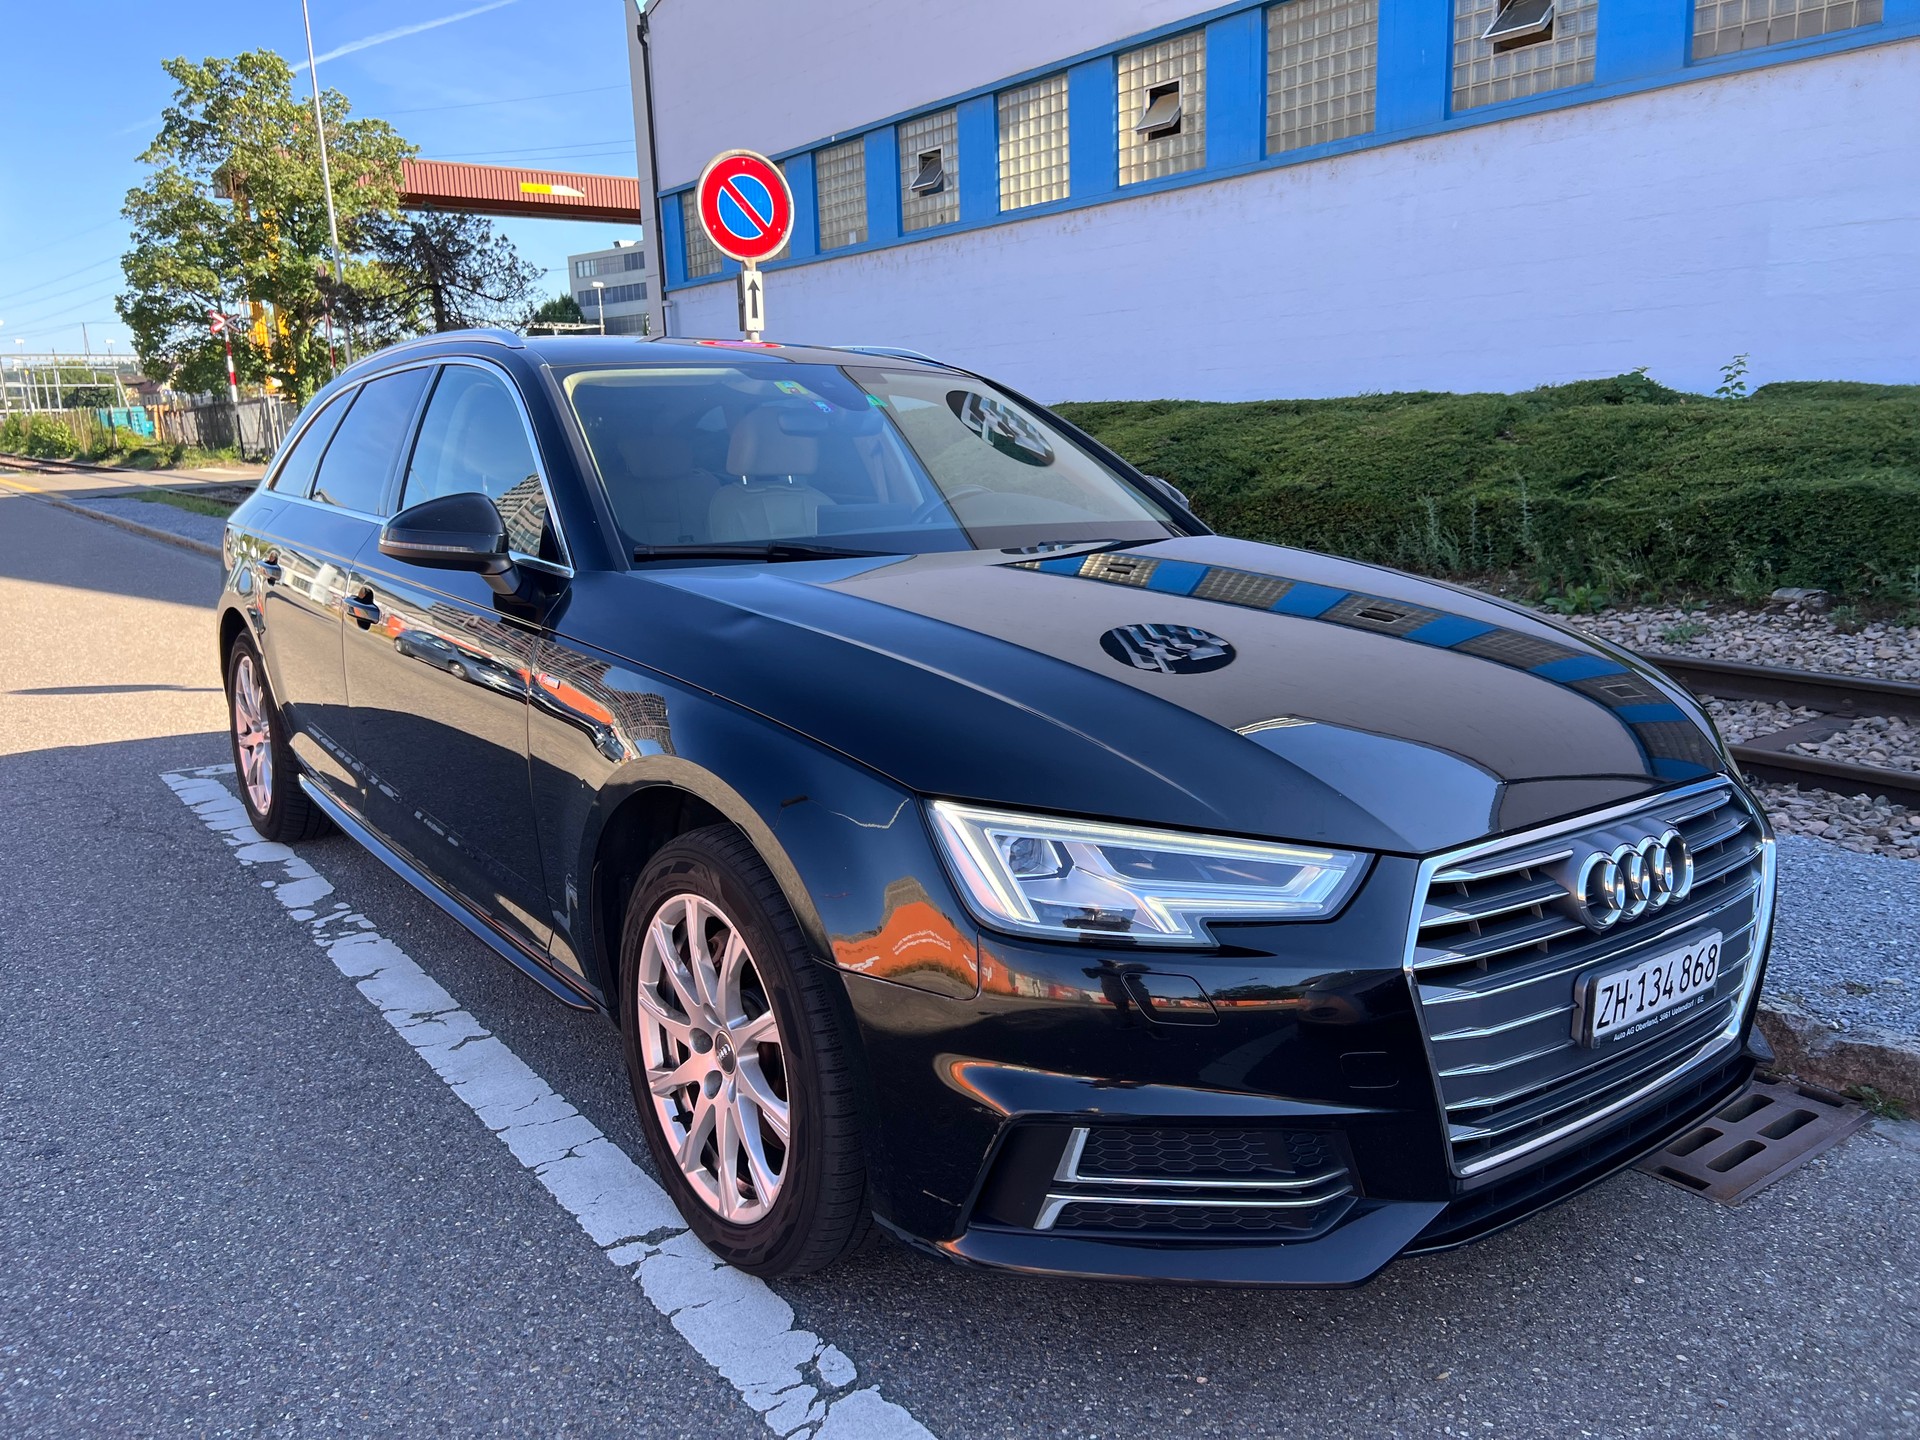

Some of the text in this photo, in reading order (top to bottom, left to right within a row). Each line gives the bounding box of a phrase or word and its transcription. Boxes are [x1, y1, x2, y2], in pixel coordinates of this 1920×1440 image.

[1680, 943, 1718, 993] 868
[1613, 1032, 1626, 1041] Auto
[1626, 1027, 1635, 1036] AG
[1635, 1016, 1659, 1032] Oberland,
[1697, 994, 1705, 1005] BE
